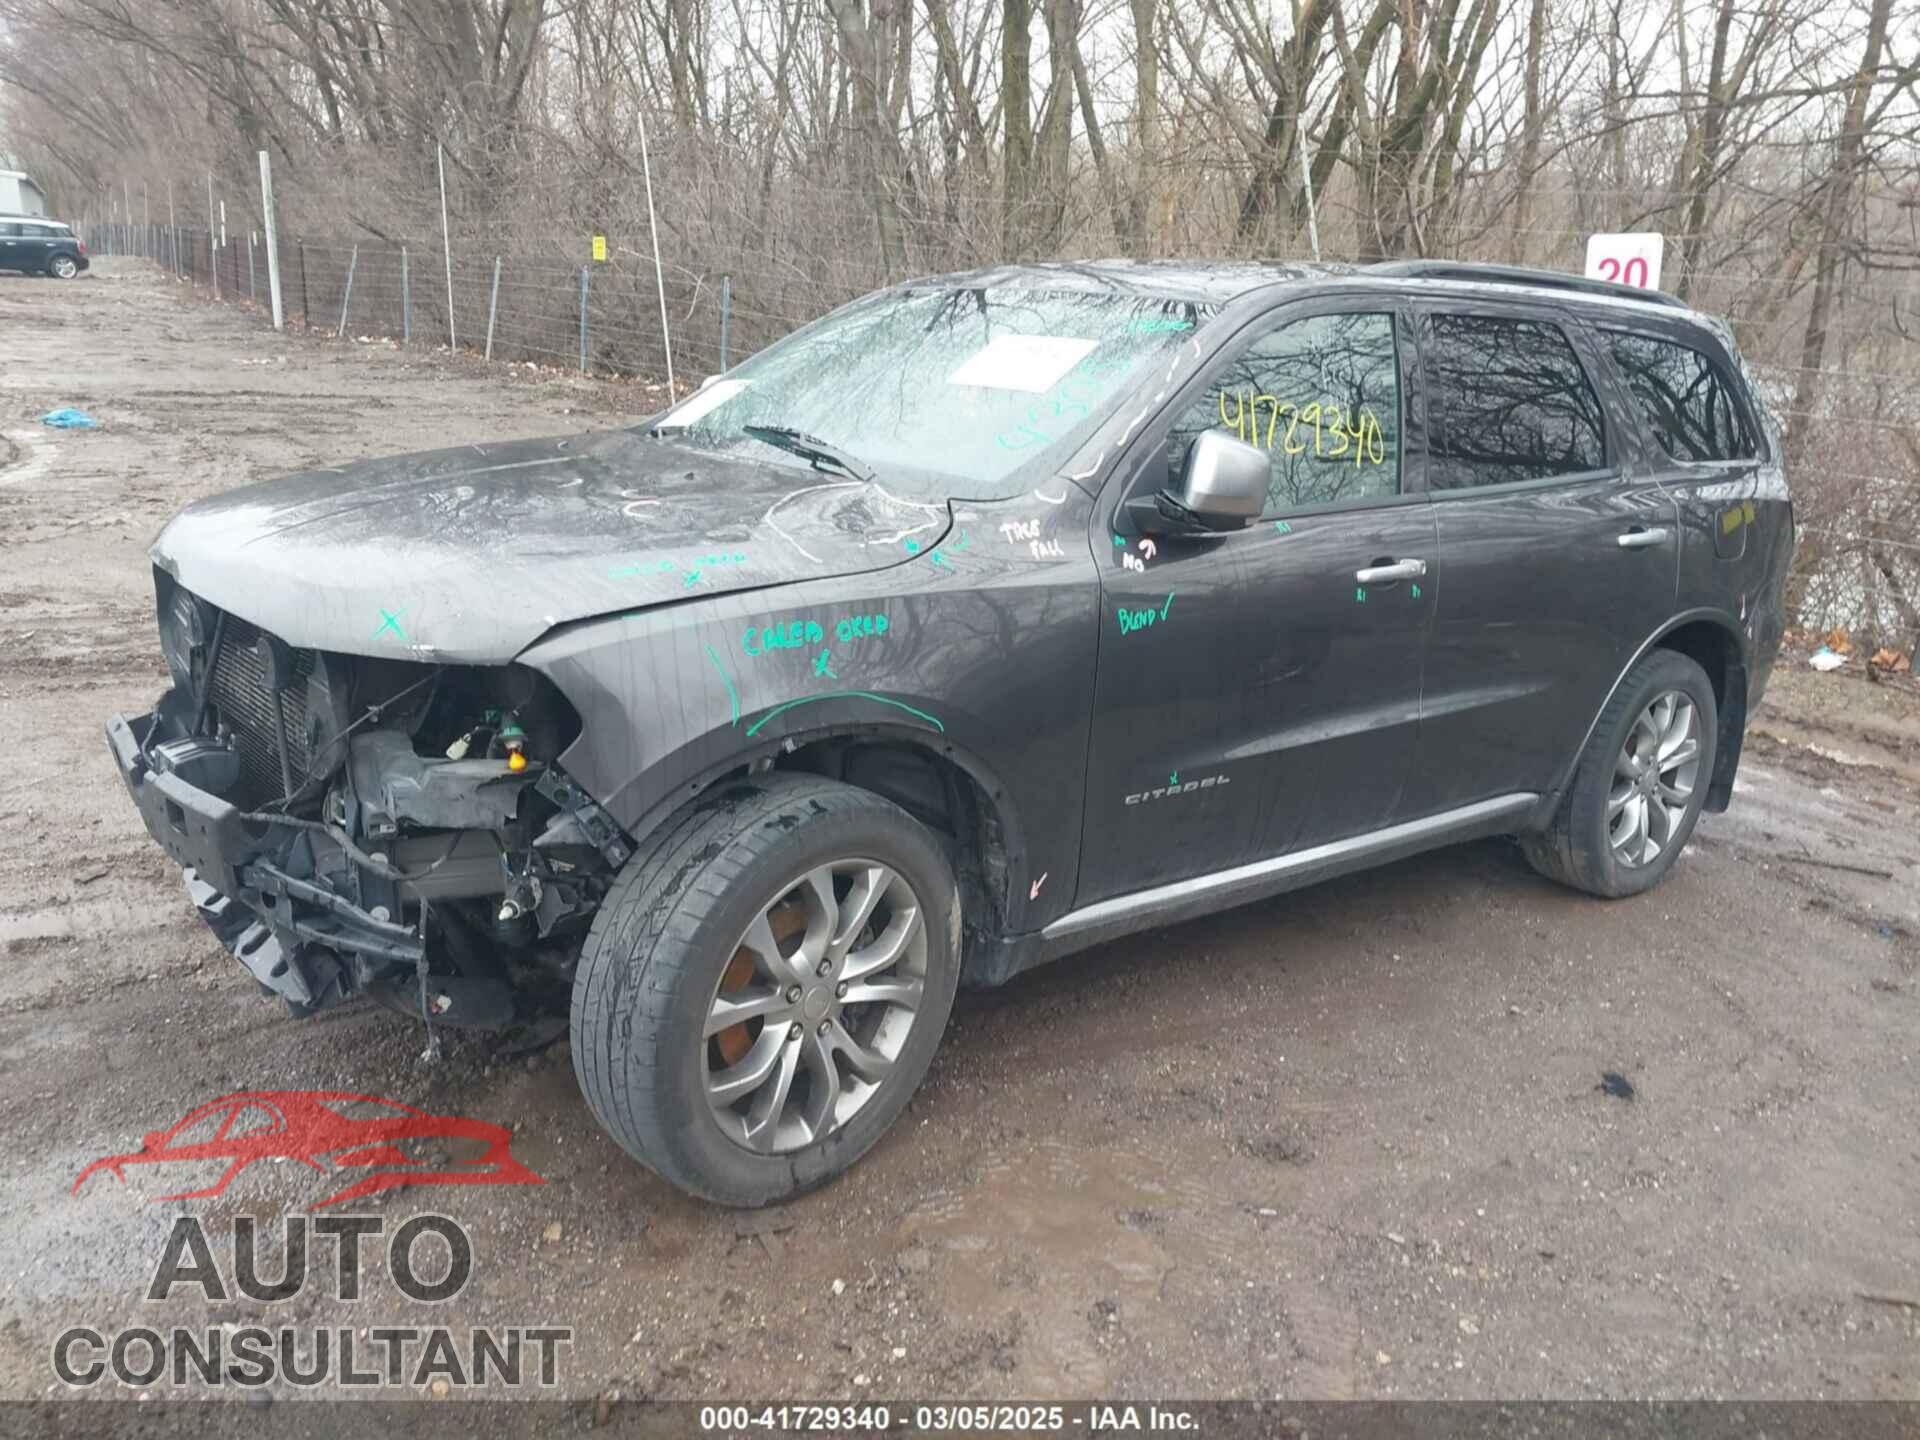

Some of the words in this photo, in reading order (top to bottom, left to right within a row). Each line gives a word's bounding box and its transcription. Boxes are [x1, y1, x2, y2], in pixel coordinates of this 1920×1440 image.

[1598, 257, 1648, 288] 20
[1219, 389, 1384, 469] 41729340
[1124, 775, 1231, 805] CITADEL
